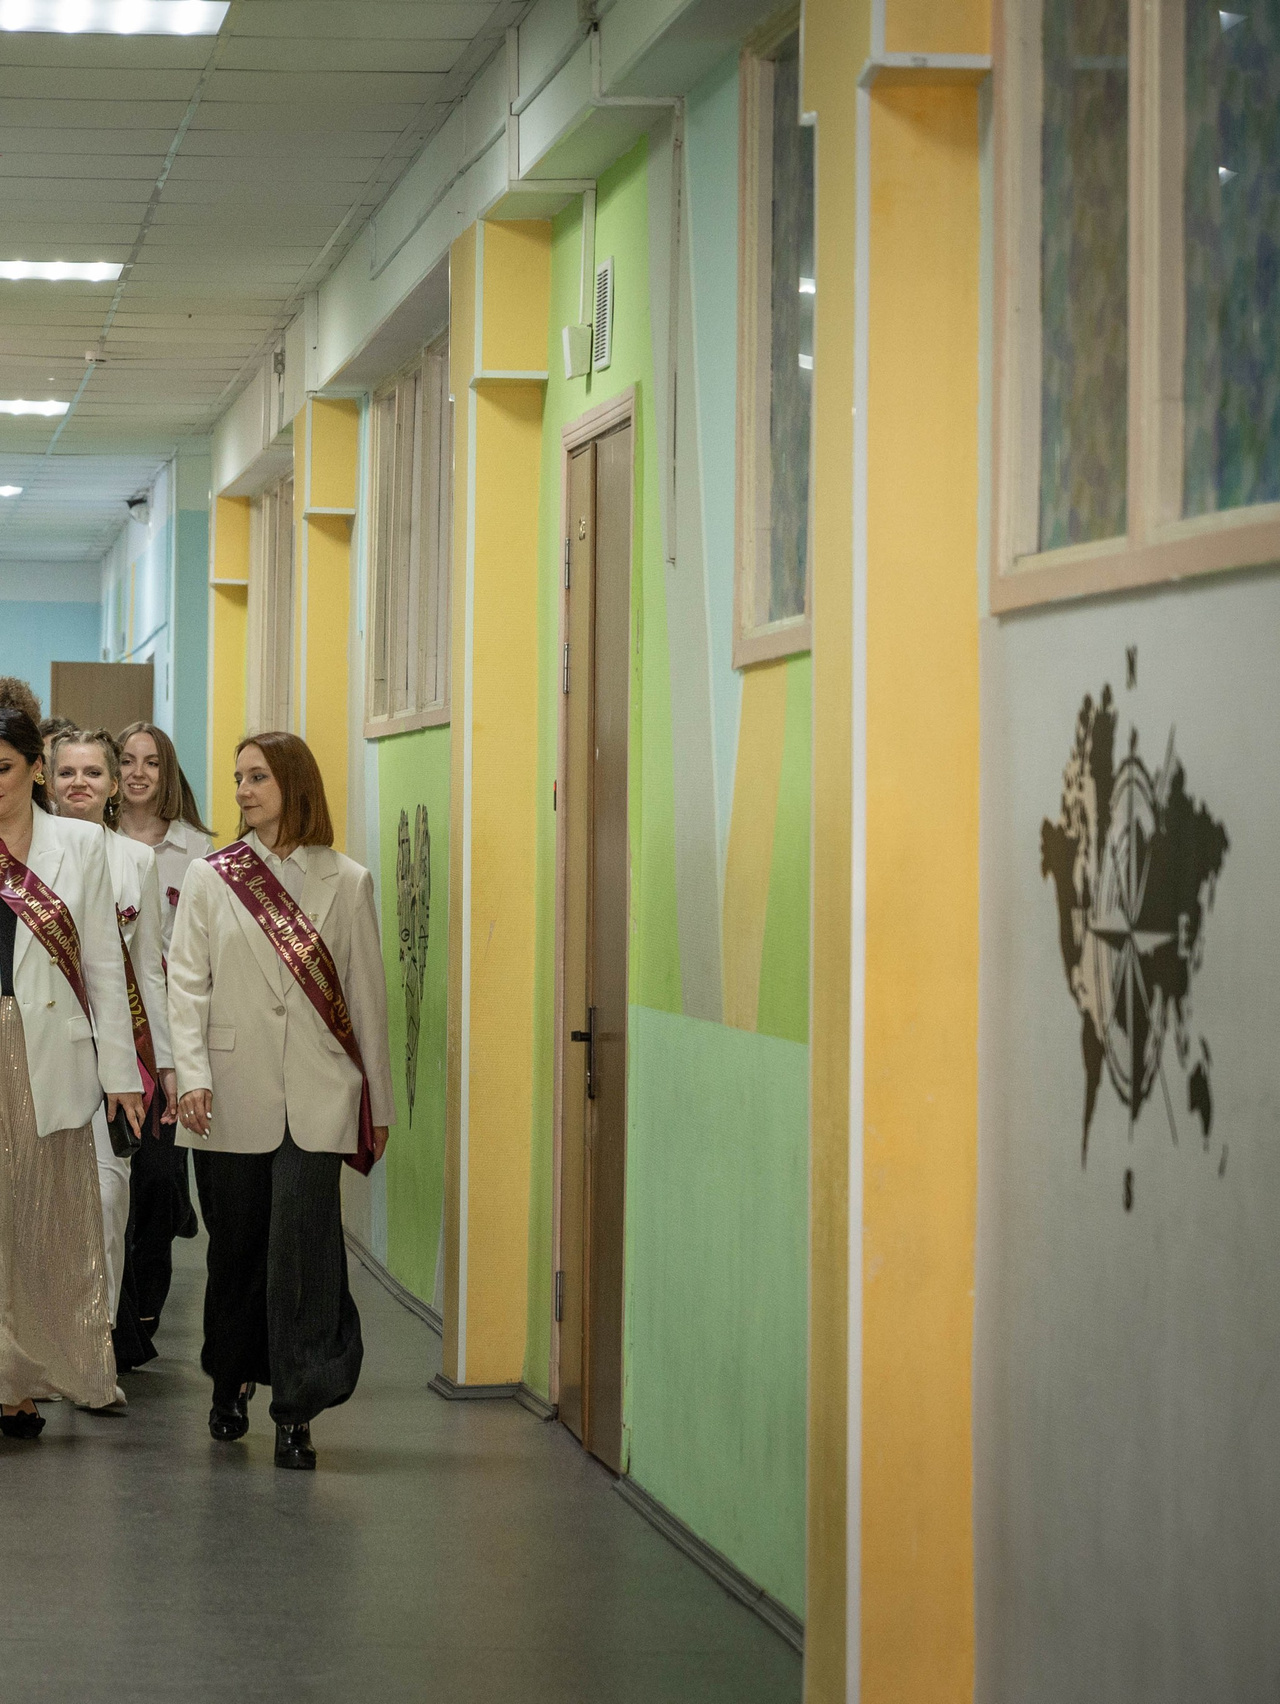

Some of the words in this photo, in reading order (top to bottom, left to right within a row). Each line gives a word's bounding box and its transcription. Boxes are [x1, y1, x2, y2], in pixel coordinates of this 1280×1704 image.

[4, 874, 55, 922] Классный
[245, 875, 292, 928] Классный
[278, 925, 334, 1000] руководитель
